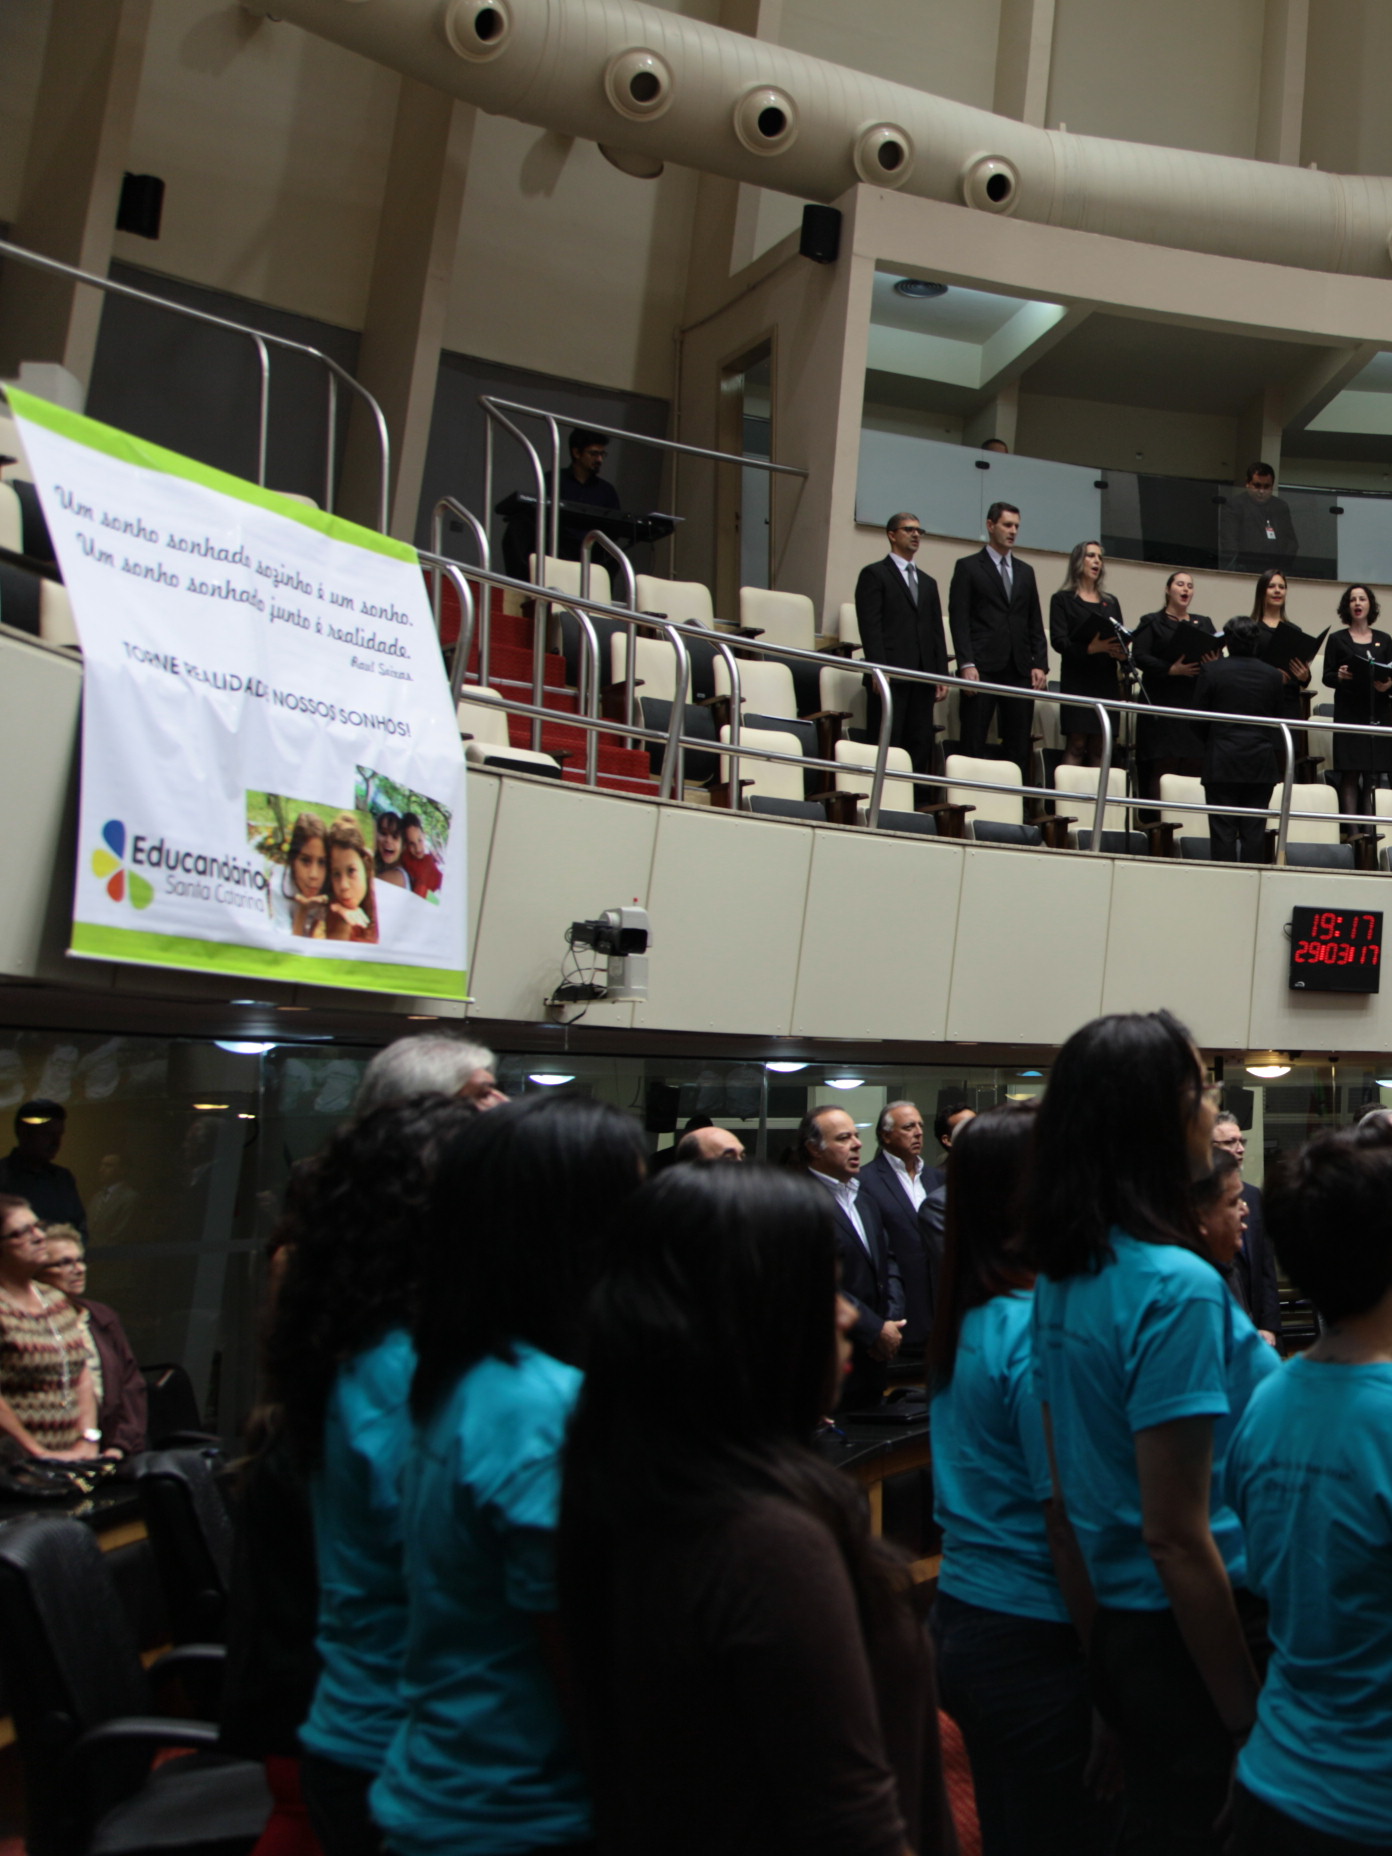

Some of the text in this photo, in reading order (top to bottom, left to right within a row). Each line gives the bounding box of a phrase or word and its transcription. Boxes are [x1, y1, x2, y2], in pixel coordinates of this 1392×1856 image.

[54, 484, 95, 522] Um
[100, 511, 159, 543] sonho
[317, 582, 325, 600] é
[329, 591, 355, 611] um
[360, 603, 414, 627] sonho.
[75, 532, 116, 568] Um
[121, 557, 180, 589] sonho
[269, 596, 311, 630] junto
[315, 616, 323, 635] é
[327, 624, 412, 660] realidade.
[350, 655, 375, 673] Raul
[273, 689, 336, 721] NOSSOS
[339, 708, 412, 738] SONHOS!
[132, 835, 267, 891] Educandário
[165, 874, 211, 900] Santa
[1311, 912, 1375, 940] 19:17
